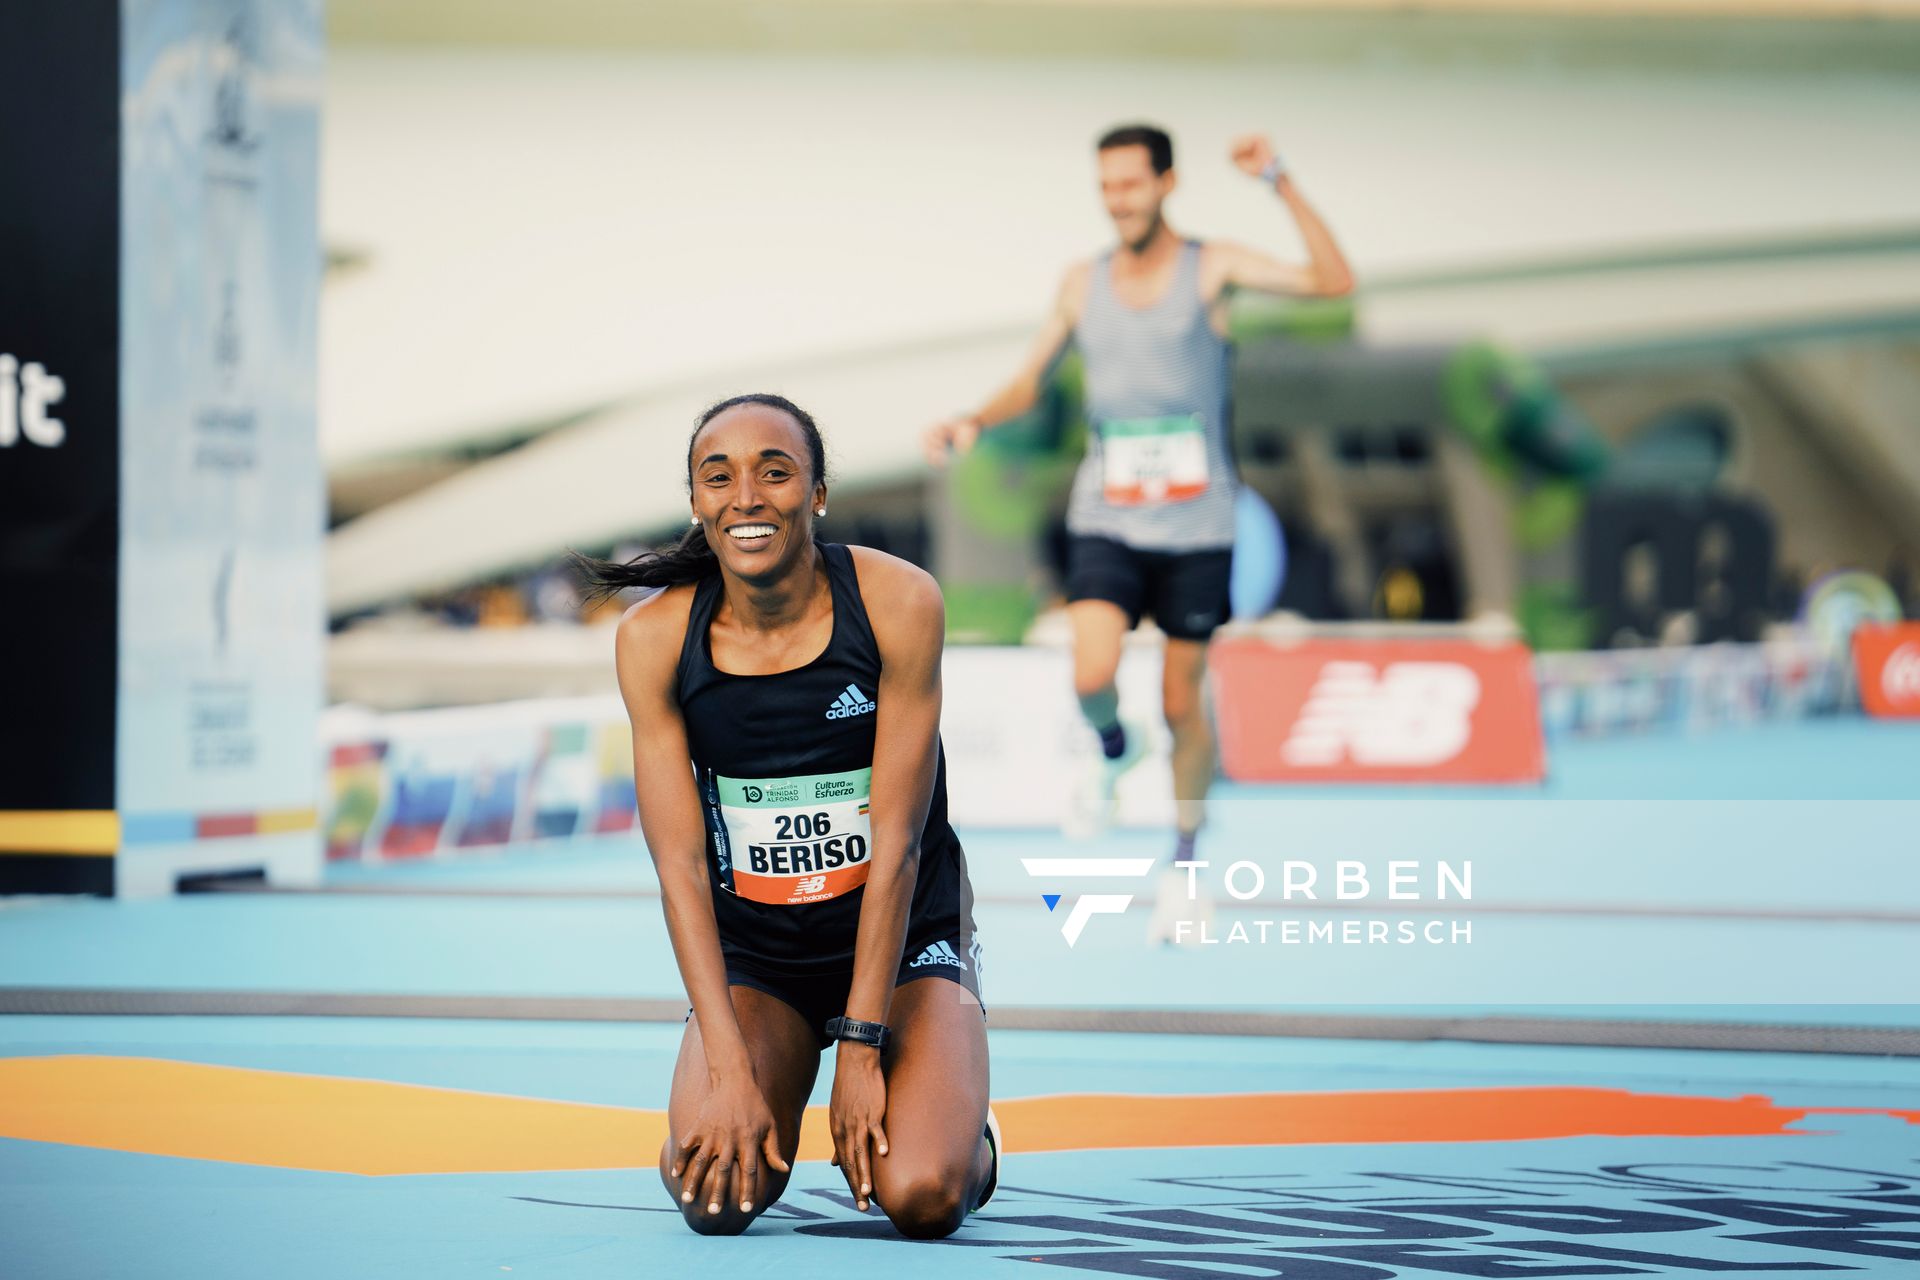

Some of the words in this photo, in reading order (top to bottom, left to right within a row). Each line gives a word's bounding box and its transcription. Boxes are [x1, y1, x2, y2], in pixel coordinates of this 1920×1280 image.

[826, 699, 876, 719] adidas
[815, 781, 845, 790] Cultura
[766, 789, 799, 797] TRINIDAD
[815, 788, 854, 799] Esfuerzo
[774, 812, 831, 840] 206
[749, 834, 867, 874] BERISO
[803, 892, 834, 903] balance
